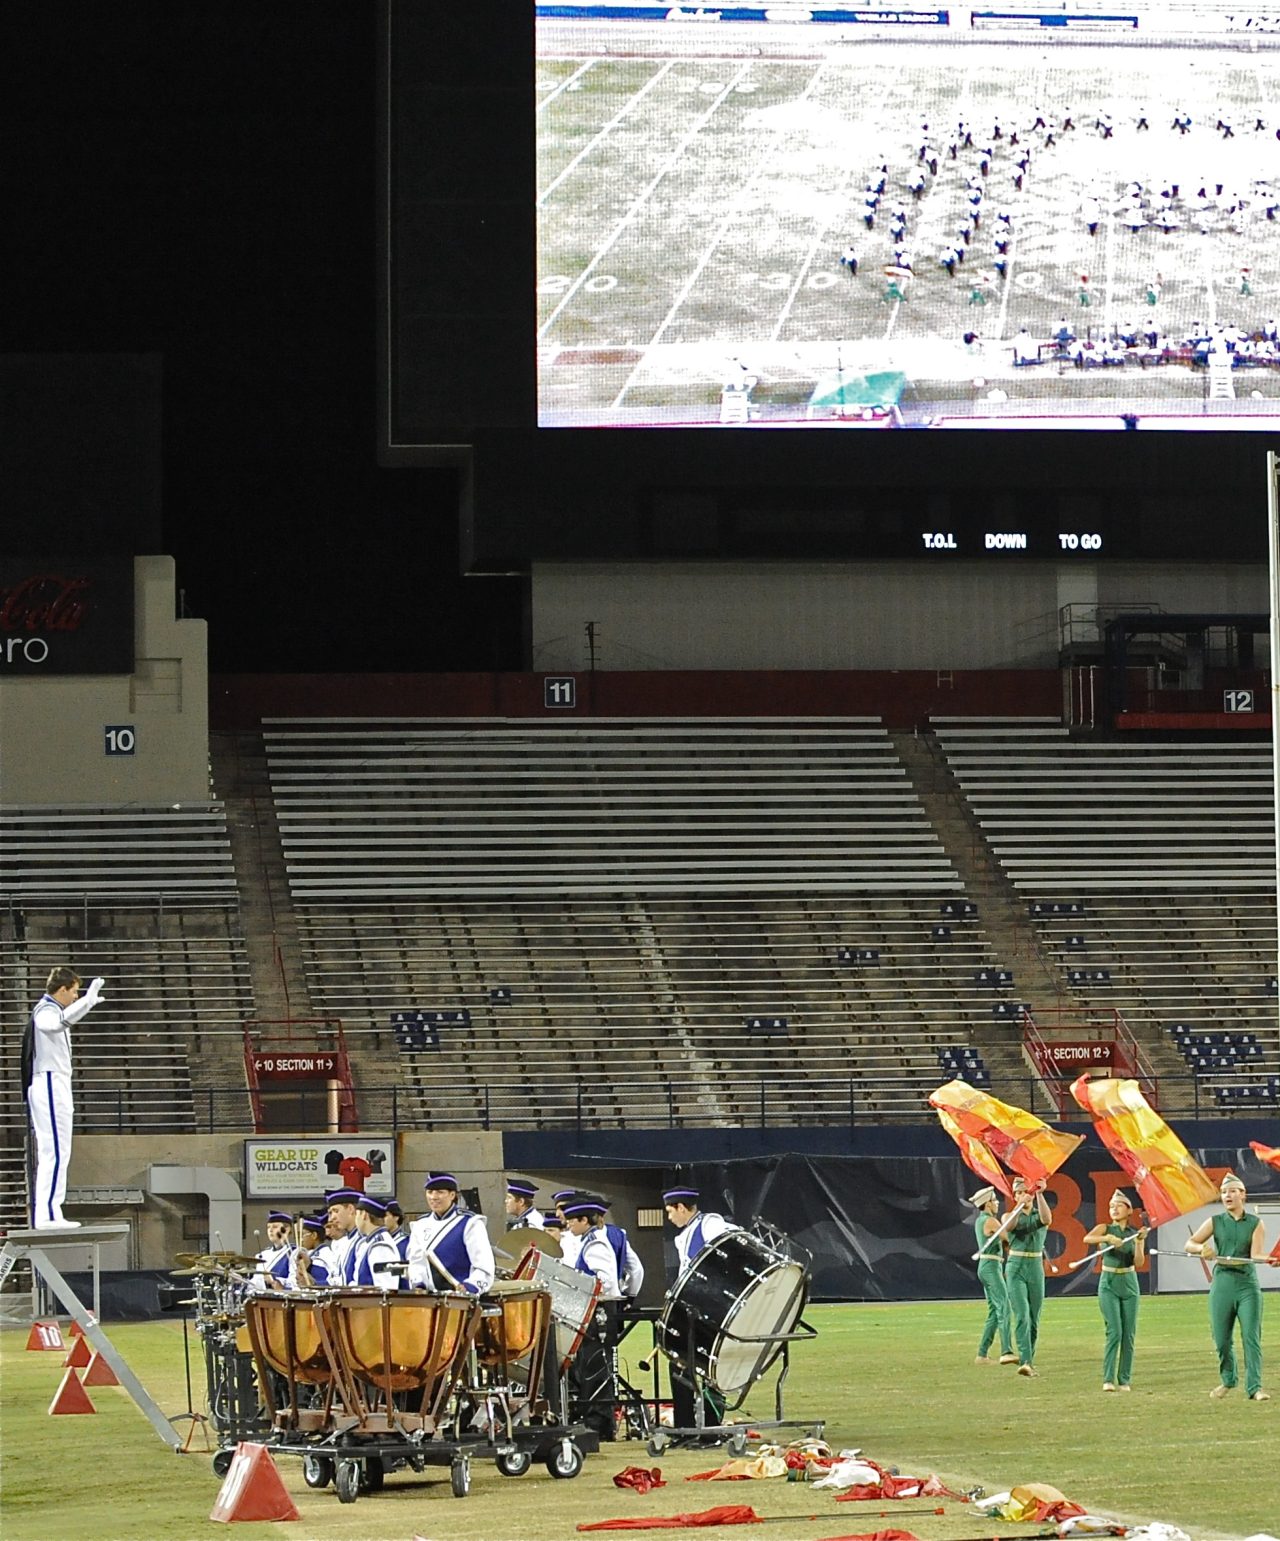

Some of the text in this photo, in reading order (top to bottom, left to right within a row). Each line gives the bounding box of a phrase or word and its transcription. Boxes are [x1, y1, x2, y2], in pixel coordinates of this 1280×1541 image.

[922, 533, 957, 548] T.O.L
[985, 533, 1027, 549] DOWN
[1059, 533, 1102, 549] TO GO
[0, 638, 48, 662] ro
[550, 682, 570, 702] 11
[1226, 691, 1252, 711] 12
[105, 729, 135, 751] 10
[1054, 1047, 1090, 1060] SECTION
[1092, 1047, 1102, 1058] 12
[263, 1059, 324, 1071] 10 SECTION 11
[255, 1149, 318, 1161] GEAR UP
[255, 1161, 318, 1172] WILDCATS
[40, 1326, 61, 1347] 10
